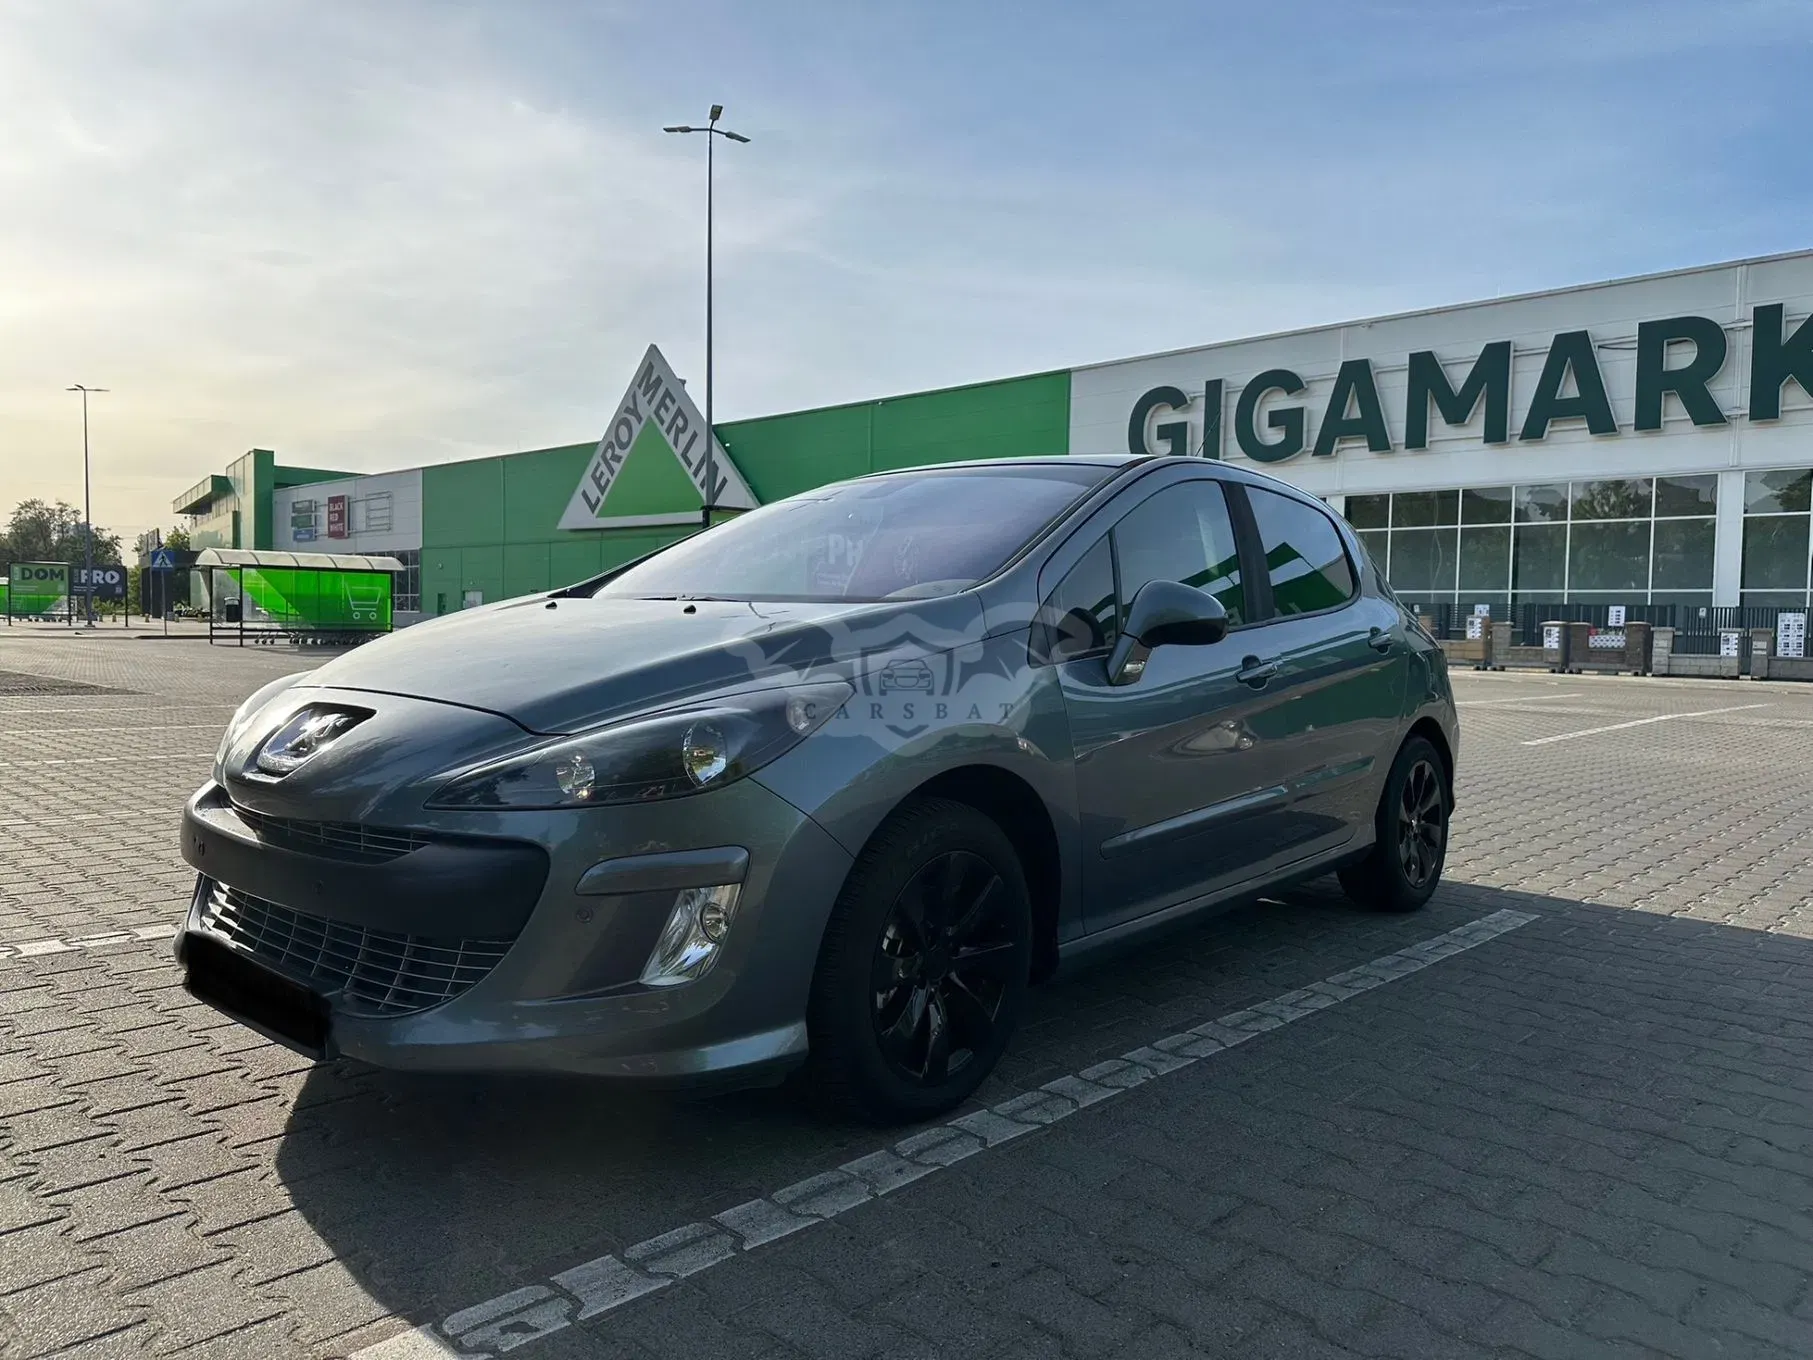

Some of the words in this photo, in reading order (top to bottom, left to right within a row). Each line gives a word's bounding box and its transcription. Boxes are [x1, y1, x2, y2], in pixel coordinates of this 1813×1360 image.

[581, 391, 643, 514] LEROY
[637, 361, 728, 505] MERLIN
[1128, 303, 1813, 462] GIGAMARK
[21, 567, 65, 581] DOM
